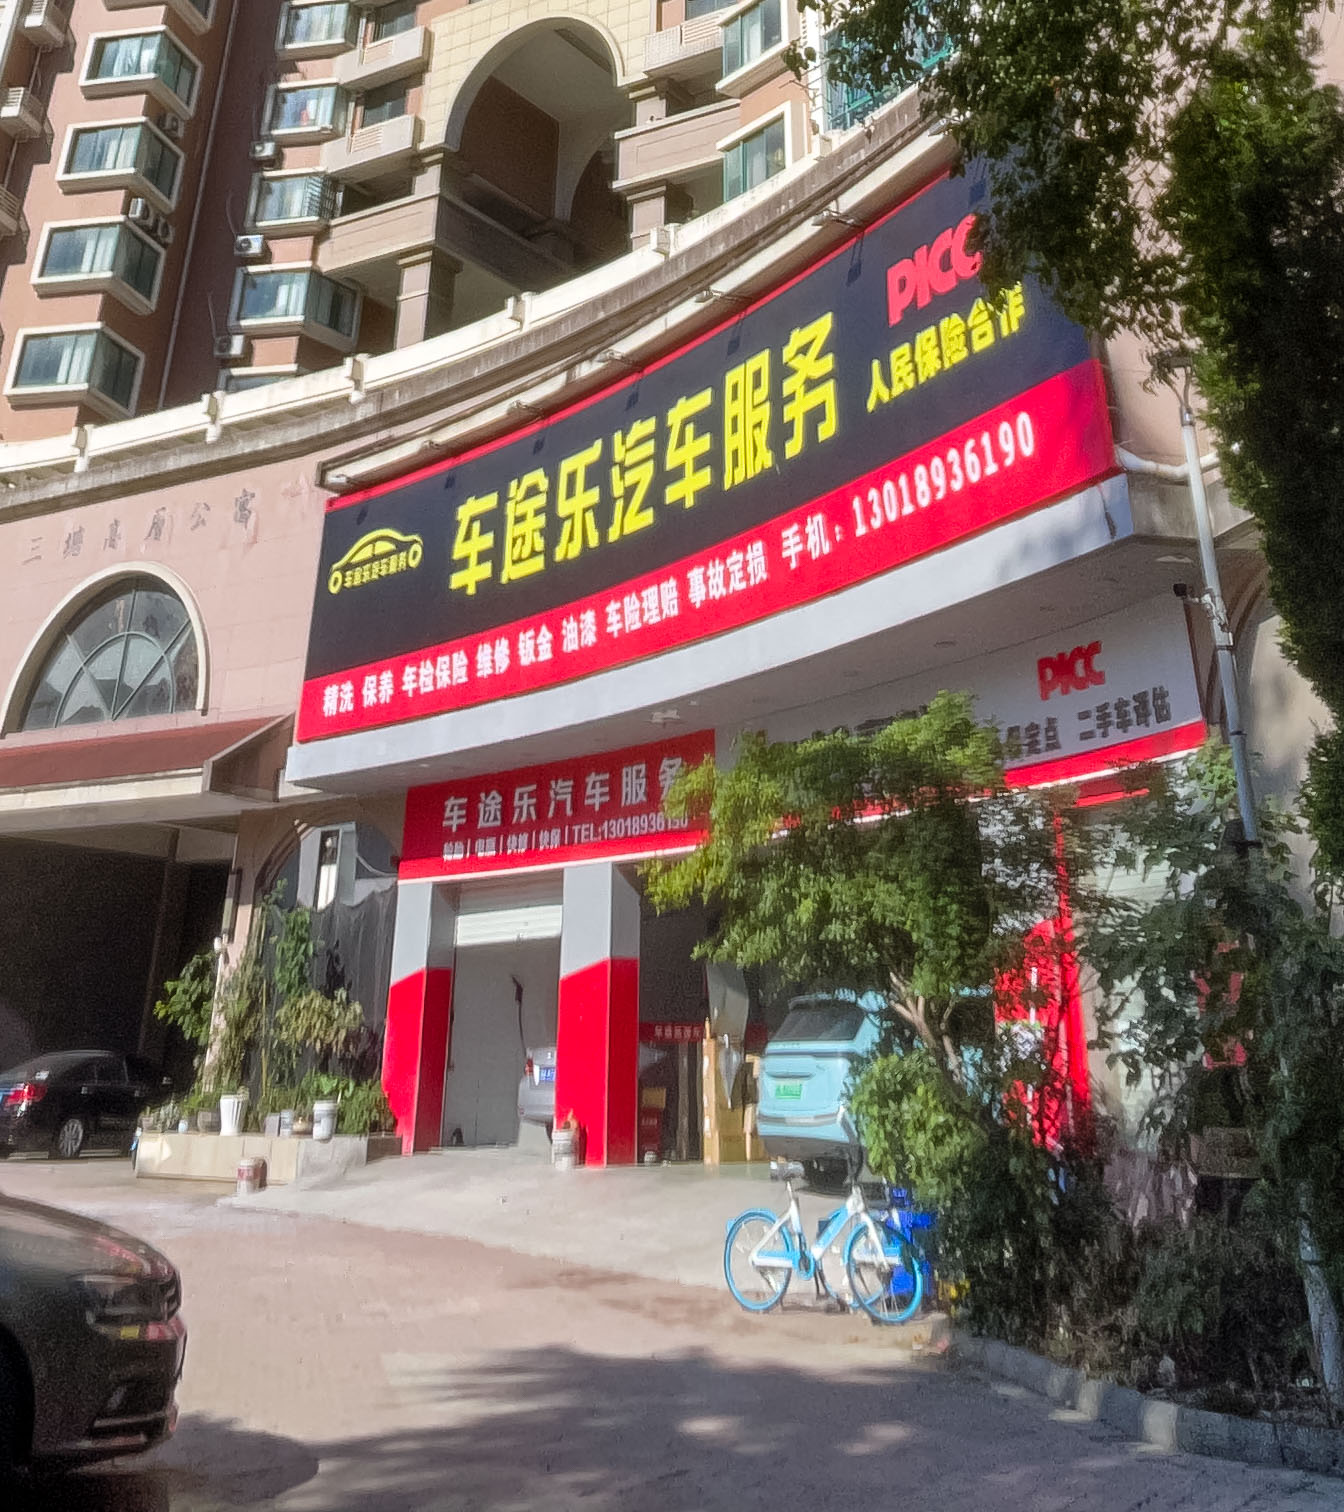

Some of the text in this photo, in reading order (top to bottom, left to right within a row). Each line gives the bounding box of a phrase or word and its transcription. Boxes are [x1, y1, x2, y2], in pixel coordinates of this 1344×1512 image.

[887, 213, 982, 328] PICC
[866, 281, 1025, 413] 人民保险合作
[449, 312, 841, 595] 车途乐汽车服务
[322, 680, 355, 717] 精洗
[362, 670, 395, 708] 保养
[401, 650, 469, 698] 年检保险
[476, 637, 511, 680] 维修
[517, 624, 554, 666] 钣金
[561, 608, 597, 654] 油漆
[605, 577, 679, 639] 车险理赔
[686, 540, 768, 609] 事故定损
[1037, 640, 1107, 701] PICC
[1078, 685, 1173, 742] 二手车评估
[442, 756, 683, 833] 车途乐汽车服务
